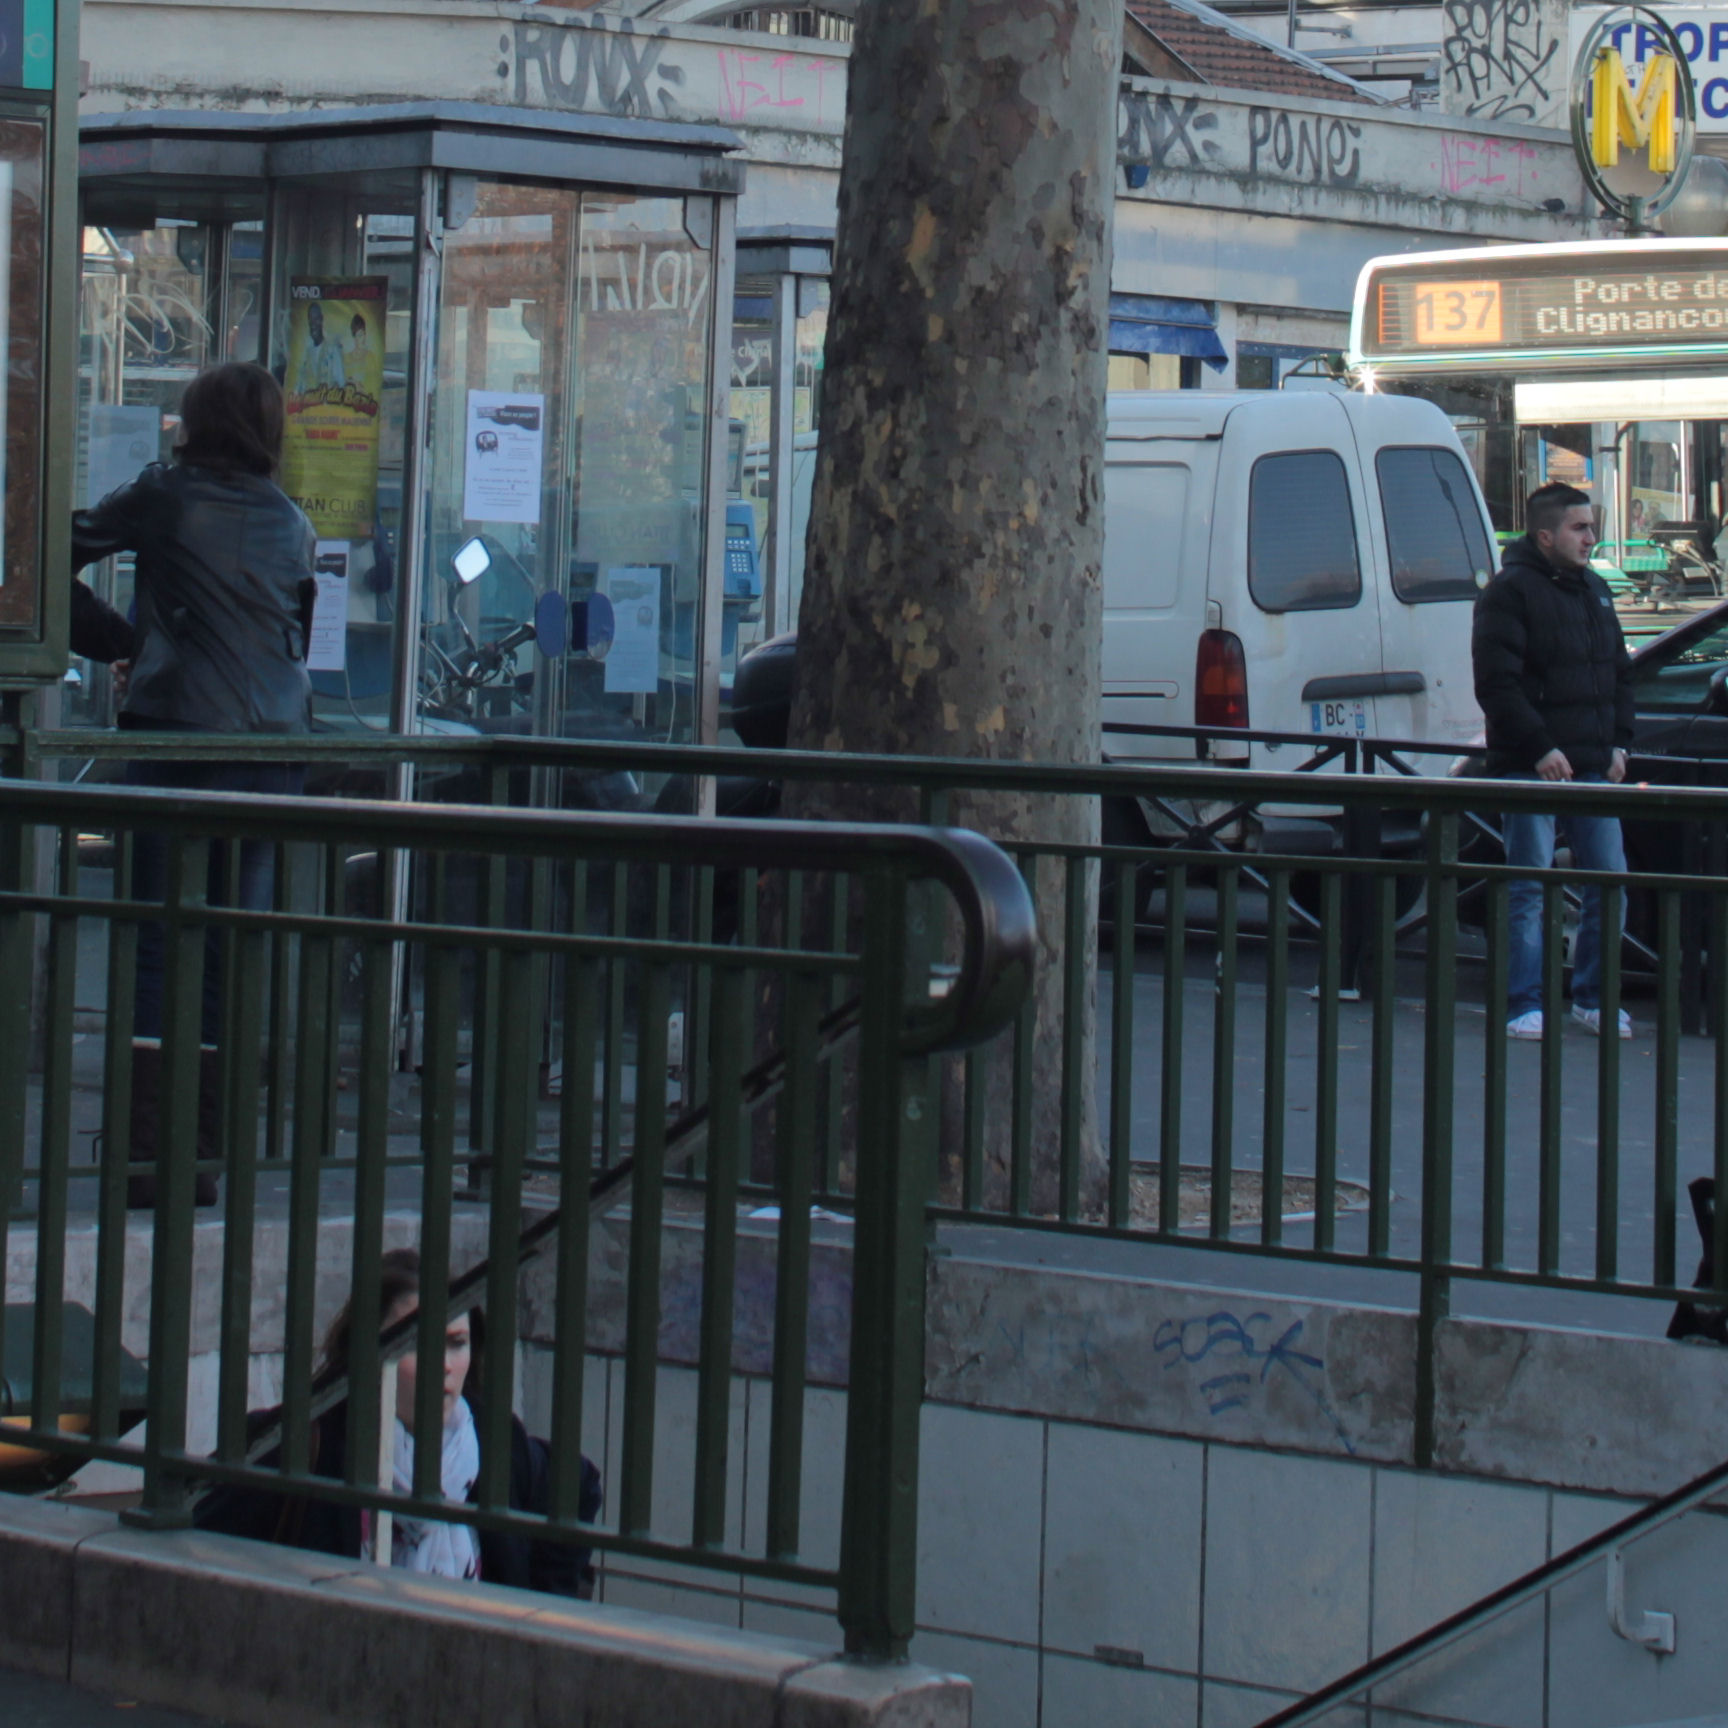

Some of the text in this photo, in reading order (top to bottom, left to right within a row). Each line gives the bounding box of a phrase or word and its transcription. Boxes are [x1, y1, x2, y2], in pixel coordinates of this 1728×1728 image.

[1593, 47, 1676, 174] M
[1417, 290, 1497, 331] 137
[1573, 276, 1682, 303] Porte
